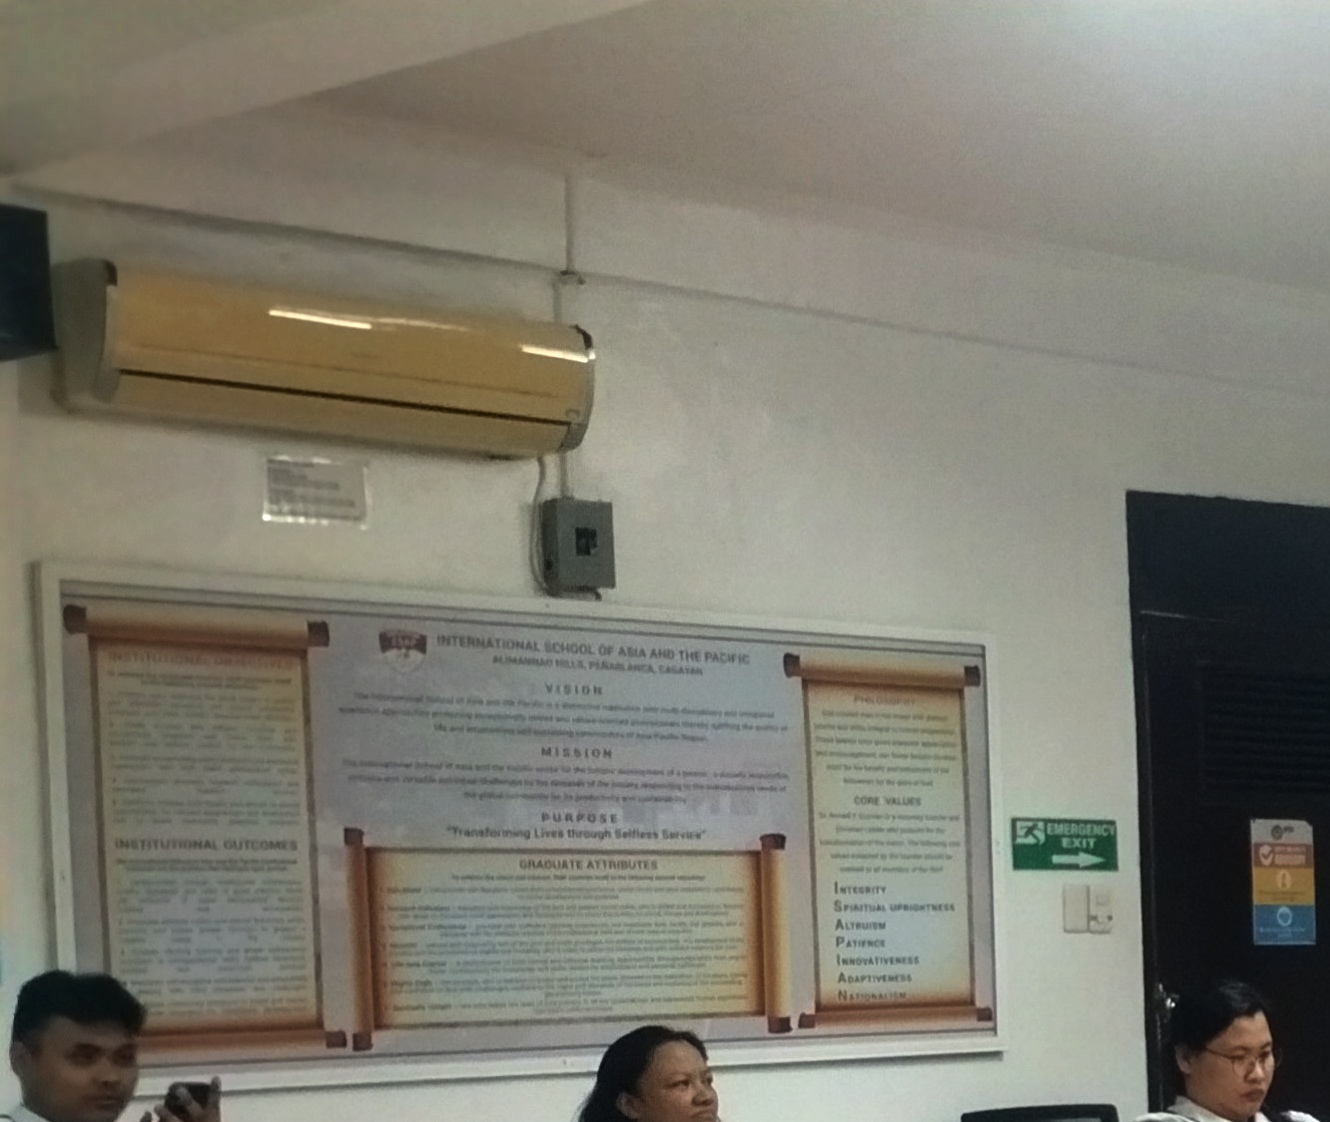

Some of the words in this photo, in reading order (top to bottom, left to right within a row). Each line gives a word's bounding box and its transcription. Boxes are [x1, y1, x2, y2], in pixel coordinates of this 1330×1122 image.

[437, 634, 540, 651] INTERNATIONAL
[544, 641, 593, 655] SCHOOL
[599, 644, 613, 657] OF
[618, 645, 647, 658] ASIA
[650, 648, 675, 660] AND
[678, 650, 701, 662] THE
[704, 651, 750, 664] PACIFIC
[545, 683, 602, 695] VISION
[541, 747, 612, 758] MISSION
[853, 796, 880, 806] CORE
[884, 797, 922, 807] VALUES
[541, 812, 618, 824] PURPOSE
[447, 826, 531, 840] "Transforming
[534, 828, 564, 839] Lives
[567, 828, 612, 840] through
[614, 829, 658, 839] Selfless
[662, 829, 706, 840] Service"
[1046, 823, 1115, 837] EMERGENCY
[115, 839, 219, 851] INSTITUTIONAL
[223, 839, 298, 851] OUTCOMES
[1061, 837, 1097, 849] EXIT
[519, 859, 583, 870] GRADUATE
[586, 860, 658, 871] ATTRIBUTES
